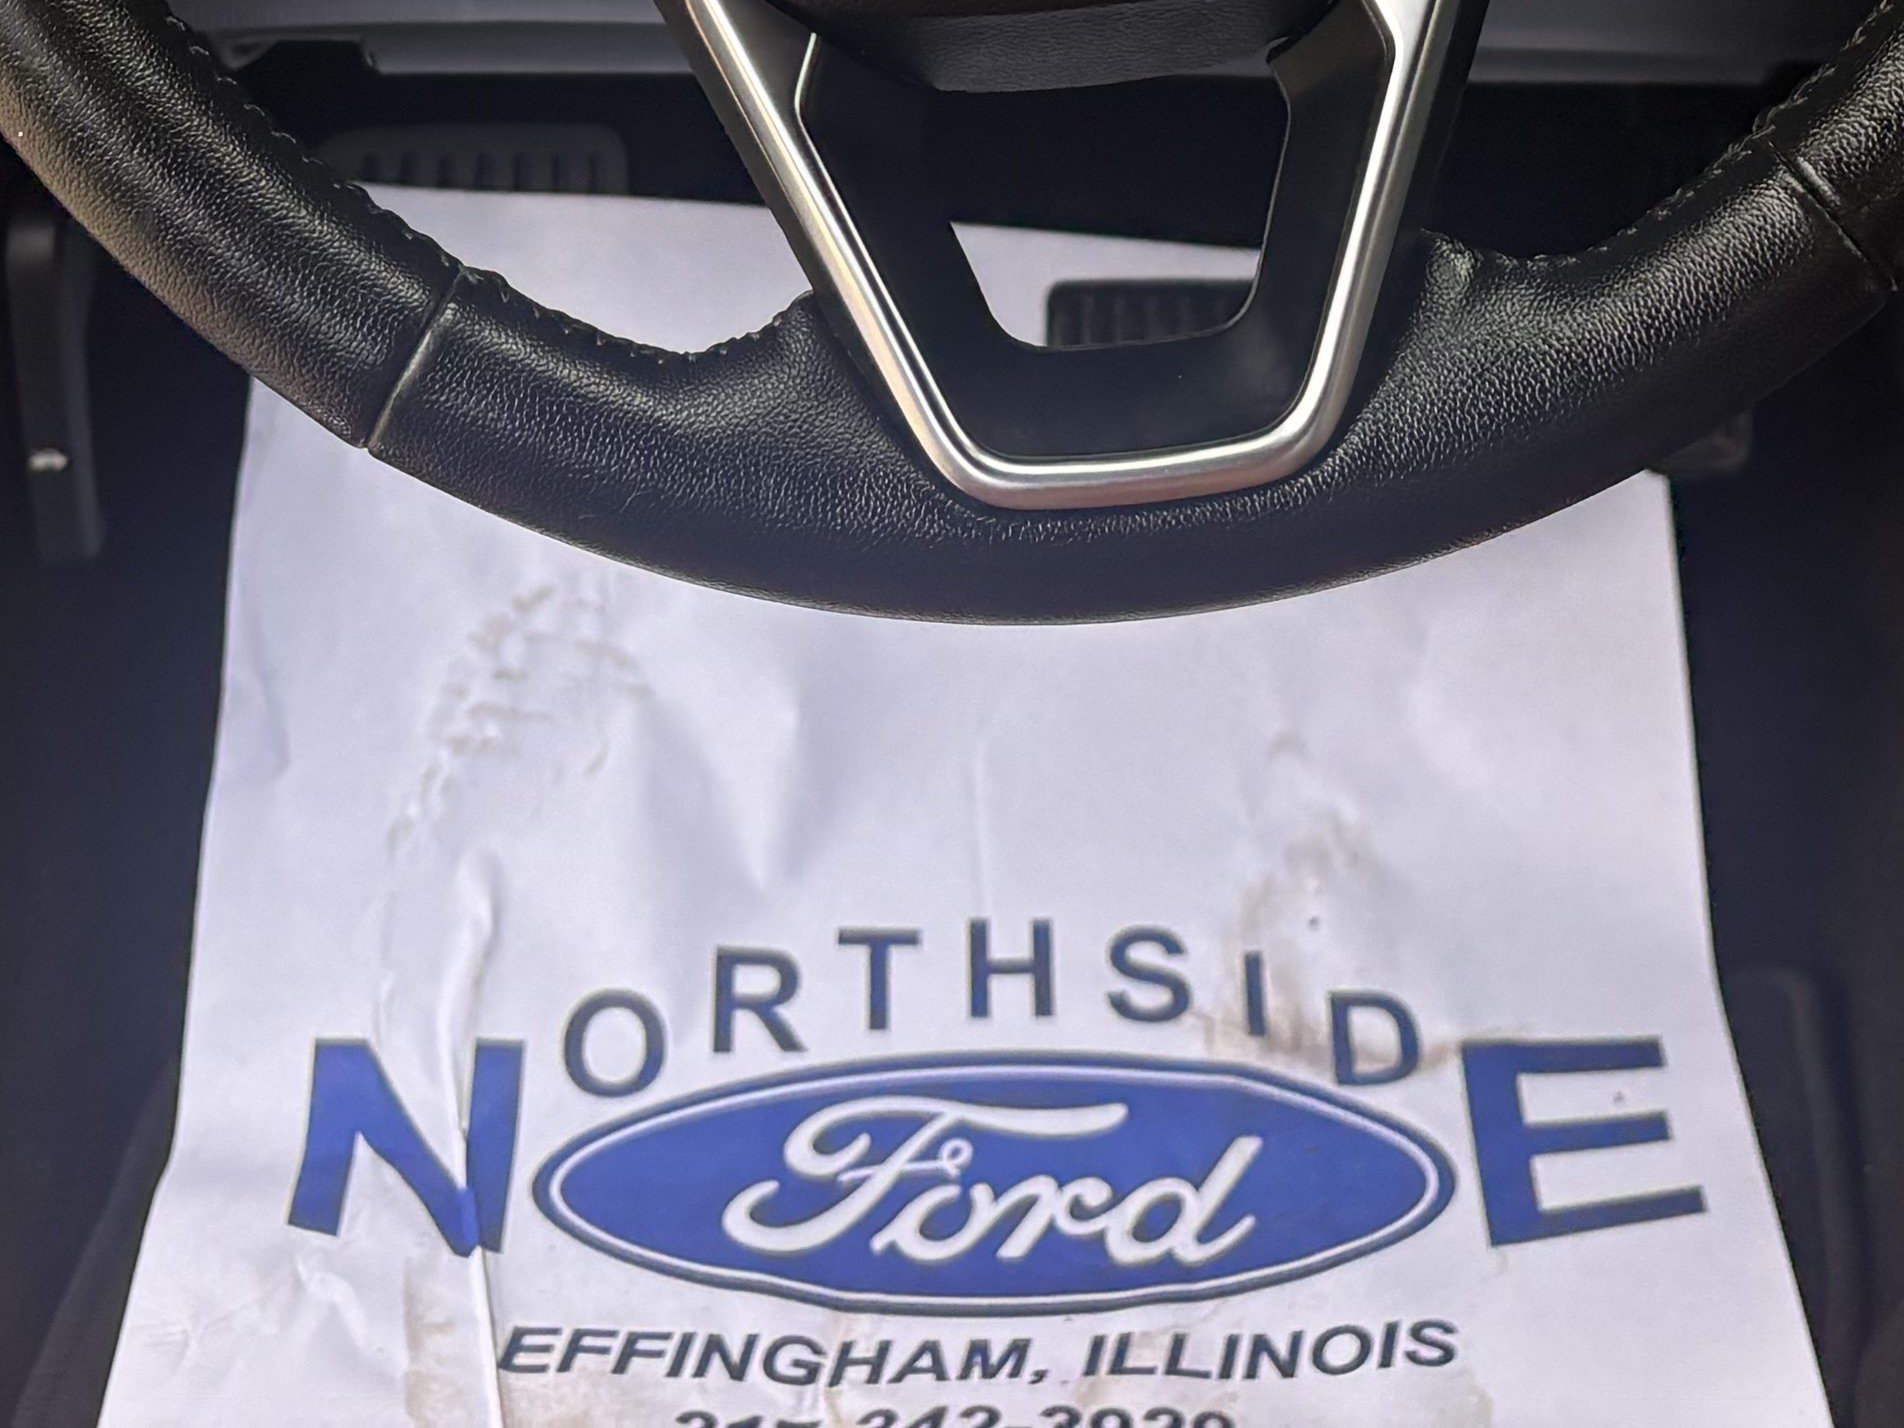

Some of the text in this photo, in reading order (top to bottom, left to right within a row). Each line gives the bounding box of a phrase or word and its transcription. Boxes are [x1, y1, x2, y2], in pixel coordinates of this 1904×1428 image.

[288, 917, 1709, 1258] NORTHSIDE
[722, 1095, 1263, 1263] Ford
[498, 1319, 1460, 1388] EFFINGHAM, ILLINOIS
